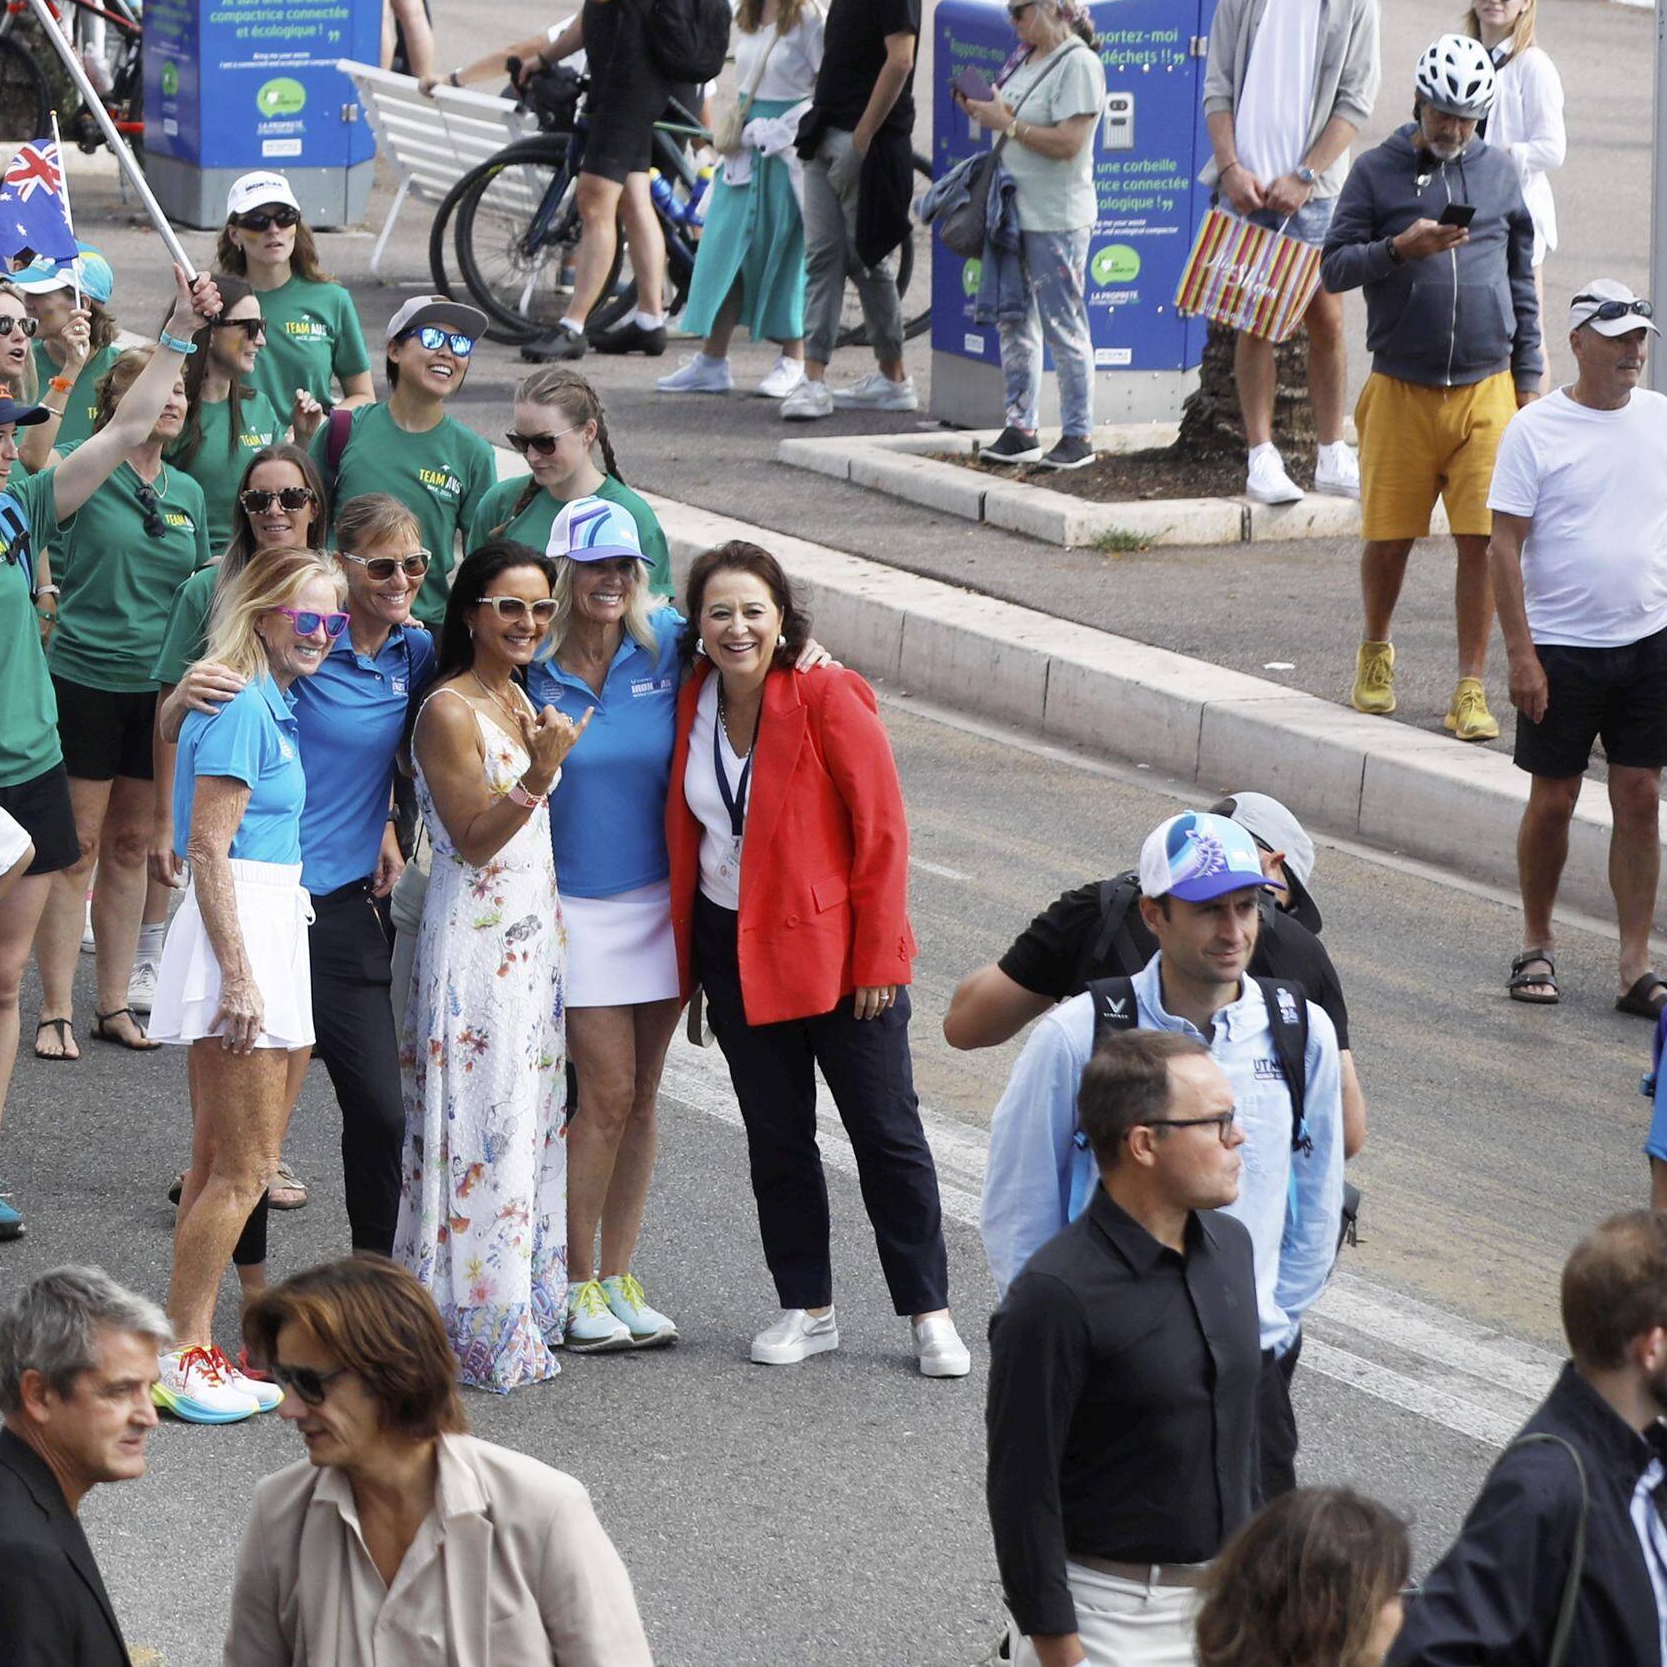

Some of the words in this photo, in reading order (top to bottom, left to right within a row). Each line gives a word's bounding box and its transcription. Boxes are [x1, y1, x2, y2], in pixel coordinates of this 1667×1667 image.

[1094, 27, 1178, 47] portez-moi
[1101, 48, 1157, 64] déchets
[1097, 162, 1118, 174] une
[1123, 158, 1177, 173] corbeille
[1123, 175, 1189, 191] connectée
[1098, 195, 1154, 212] ologique
[285, 322, 309, 335] TEAM
[419, 468, 446, 487] TEAM
[631, 678, 671, 694] IRONAN
[1254, 1058, 1280, 1073] UTM
